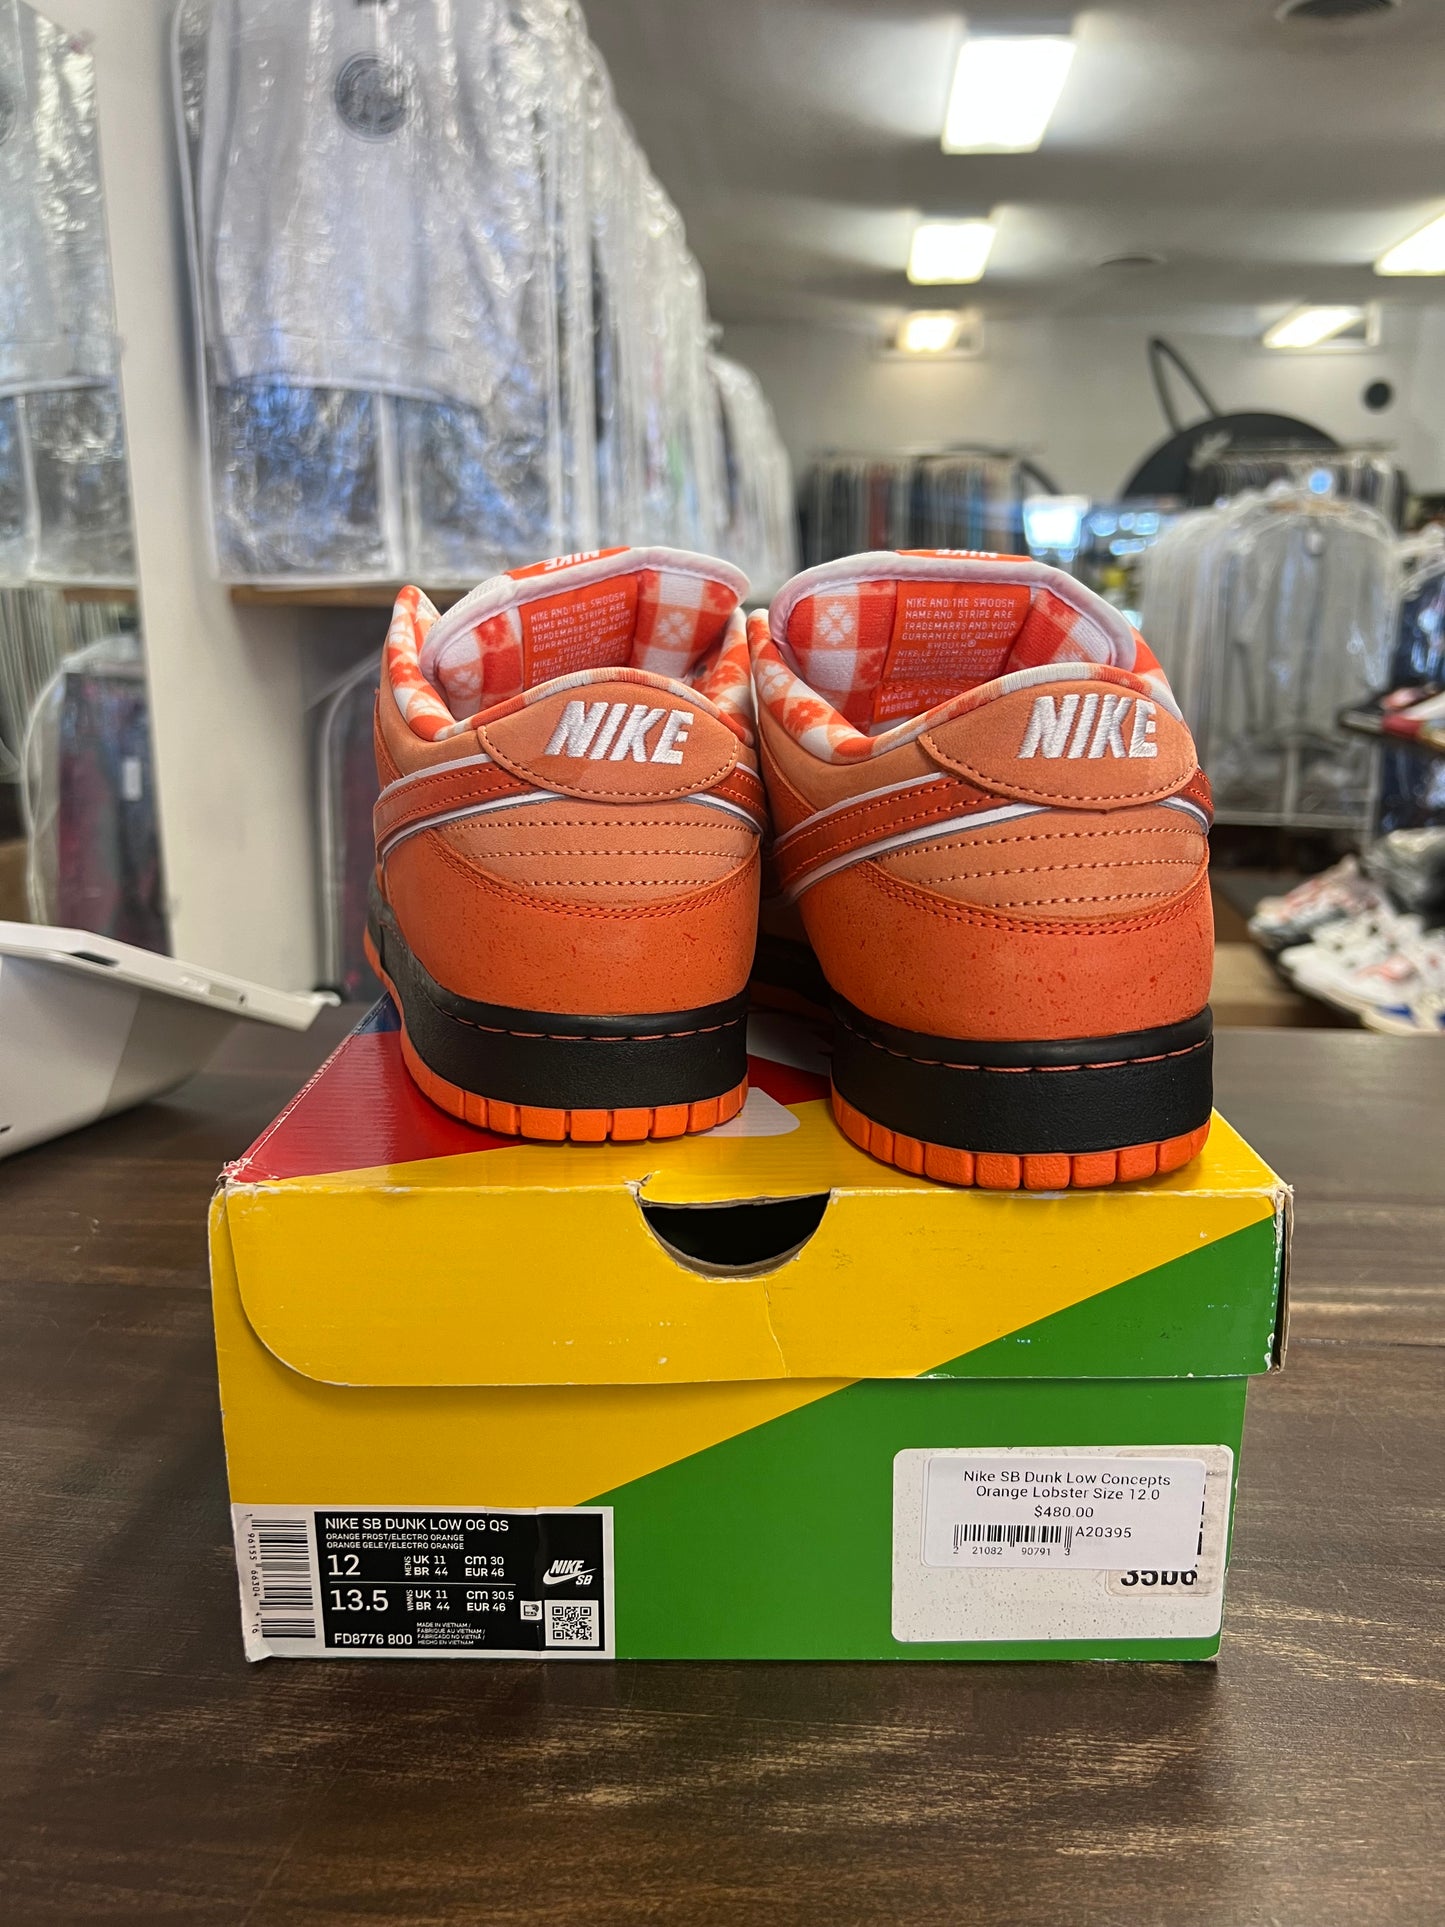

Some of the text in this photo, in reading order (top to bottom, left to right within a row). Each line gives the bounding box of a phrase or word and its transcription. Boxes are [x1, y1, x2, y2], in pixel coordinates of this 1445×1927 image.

[551, 606, 568, 618] AND
[572, 602, 586, 612] THE
[590, 592, 626, 608] SWOOSH
[906, 598, 1015, 608] NIKE AND THE SWOOSH
[532, 602, 625, 633] NAME AND STRIPE ARE
[905, 610, 1013, 619] NAME AND STRIPE ARE
[533, 624, 588, 643] TRADEMARKS
[590, 618, 607, 628] AND
[968, 622, 988, 630] AND
[991, 621, 1016, 630] YOUR
[902, 631, 1014, 640] GUARANTEE OF QUALITY
[534, 634, 582, 653] GUARANTEE
[881, 688, 961, 703] MADE IN VIET
[880, 700, 920, 714] FABRIQUE
[544, 700, 694, 766] NIKE
[1017, 693, 1158, 759] NIKE
[964, 1470, 1171, 1488] Nike SB Dunk Low Concepts
[976, 1486, 1160, 1501] Orange Lobster Size 12.0
[1034, 1505, 1094, 1519] $480.00
[325, 1518, 509, 1532] NIKE SB DUNK LOW OG QS
[362, 1533, 428, 1541] FROST/ELECTRO
[1075, 1526, 1132, 1539] A20395
[248, 1533, 258, 1560] 96155
[953, 1546, 1070, 1556] 2 21082 90791 3
[328, 1554, 361, 1576] 12
[404, 1556, 412, 1576] MENS
[413, 1556, 446, 1565] UK 11
[464, 1556, 504, 1566] cm 30
[550, 1560, 584, 1574] NIKE
[414, 1567, 448, 1576] BR 44
[465, 1568, 504, 1577] EUR 46
[576, 1574, 593, 1585] SB
[330, 1589, 389, 1611] 13.5
[406, 1590, 415, 1612] WMNS
[415, 1590, 448, 1599] UK 11
[466, 1590, 514, 1600] cm 30.5
[416, 1602, 450, 1612] BR 44
[466, 1602, 506, 1612] EUR 46
[334, 1633, 412, 1645] FD8776 800
